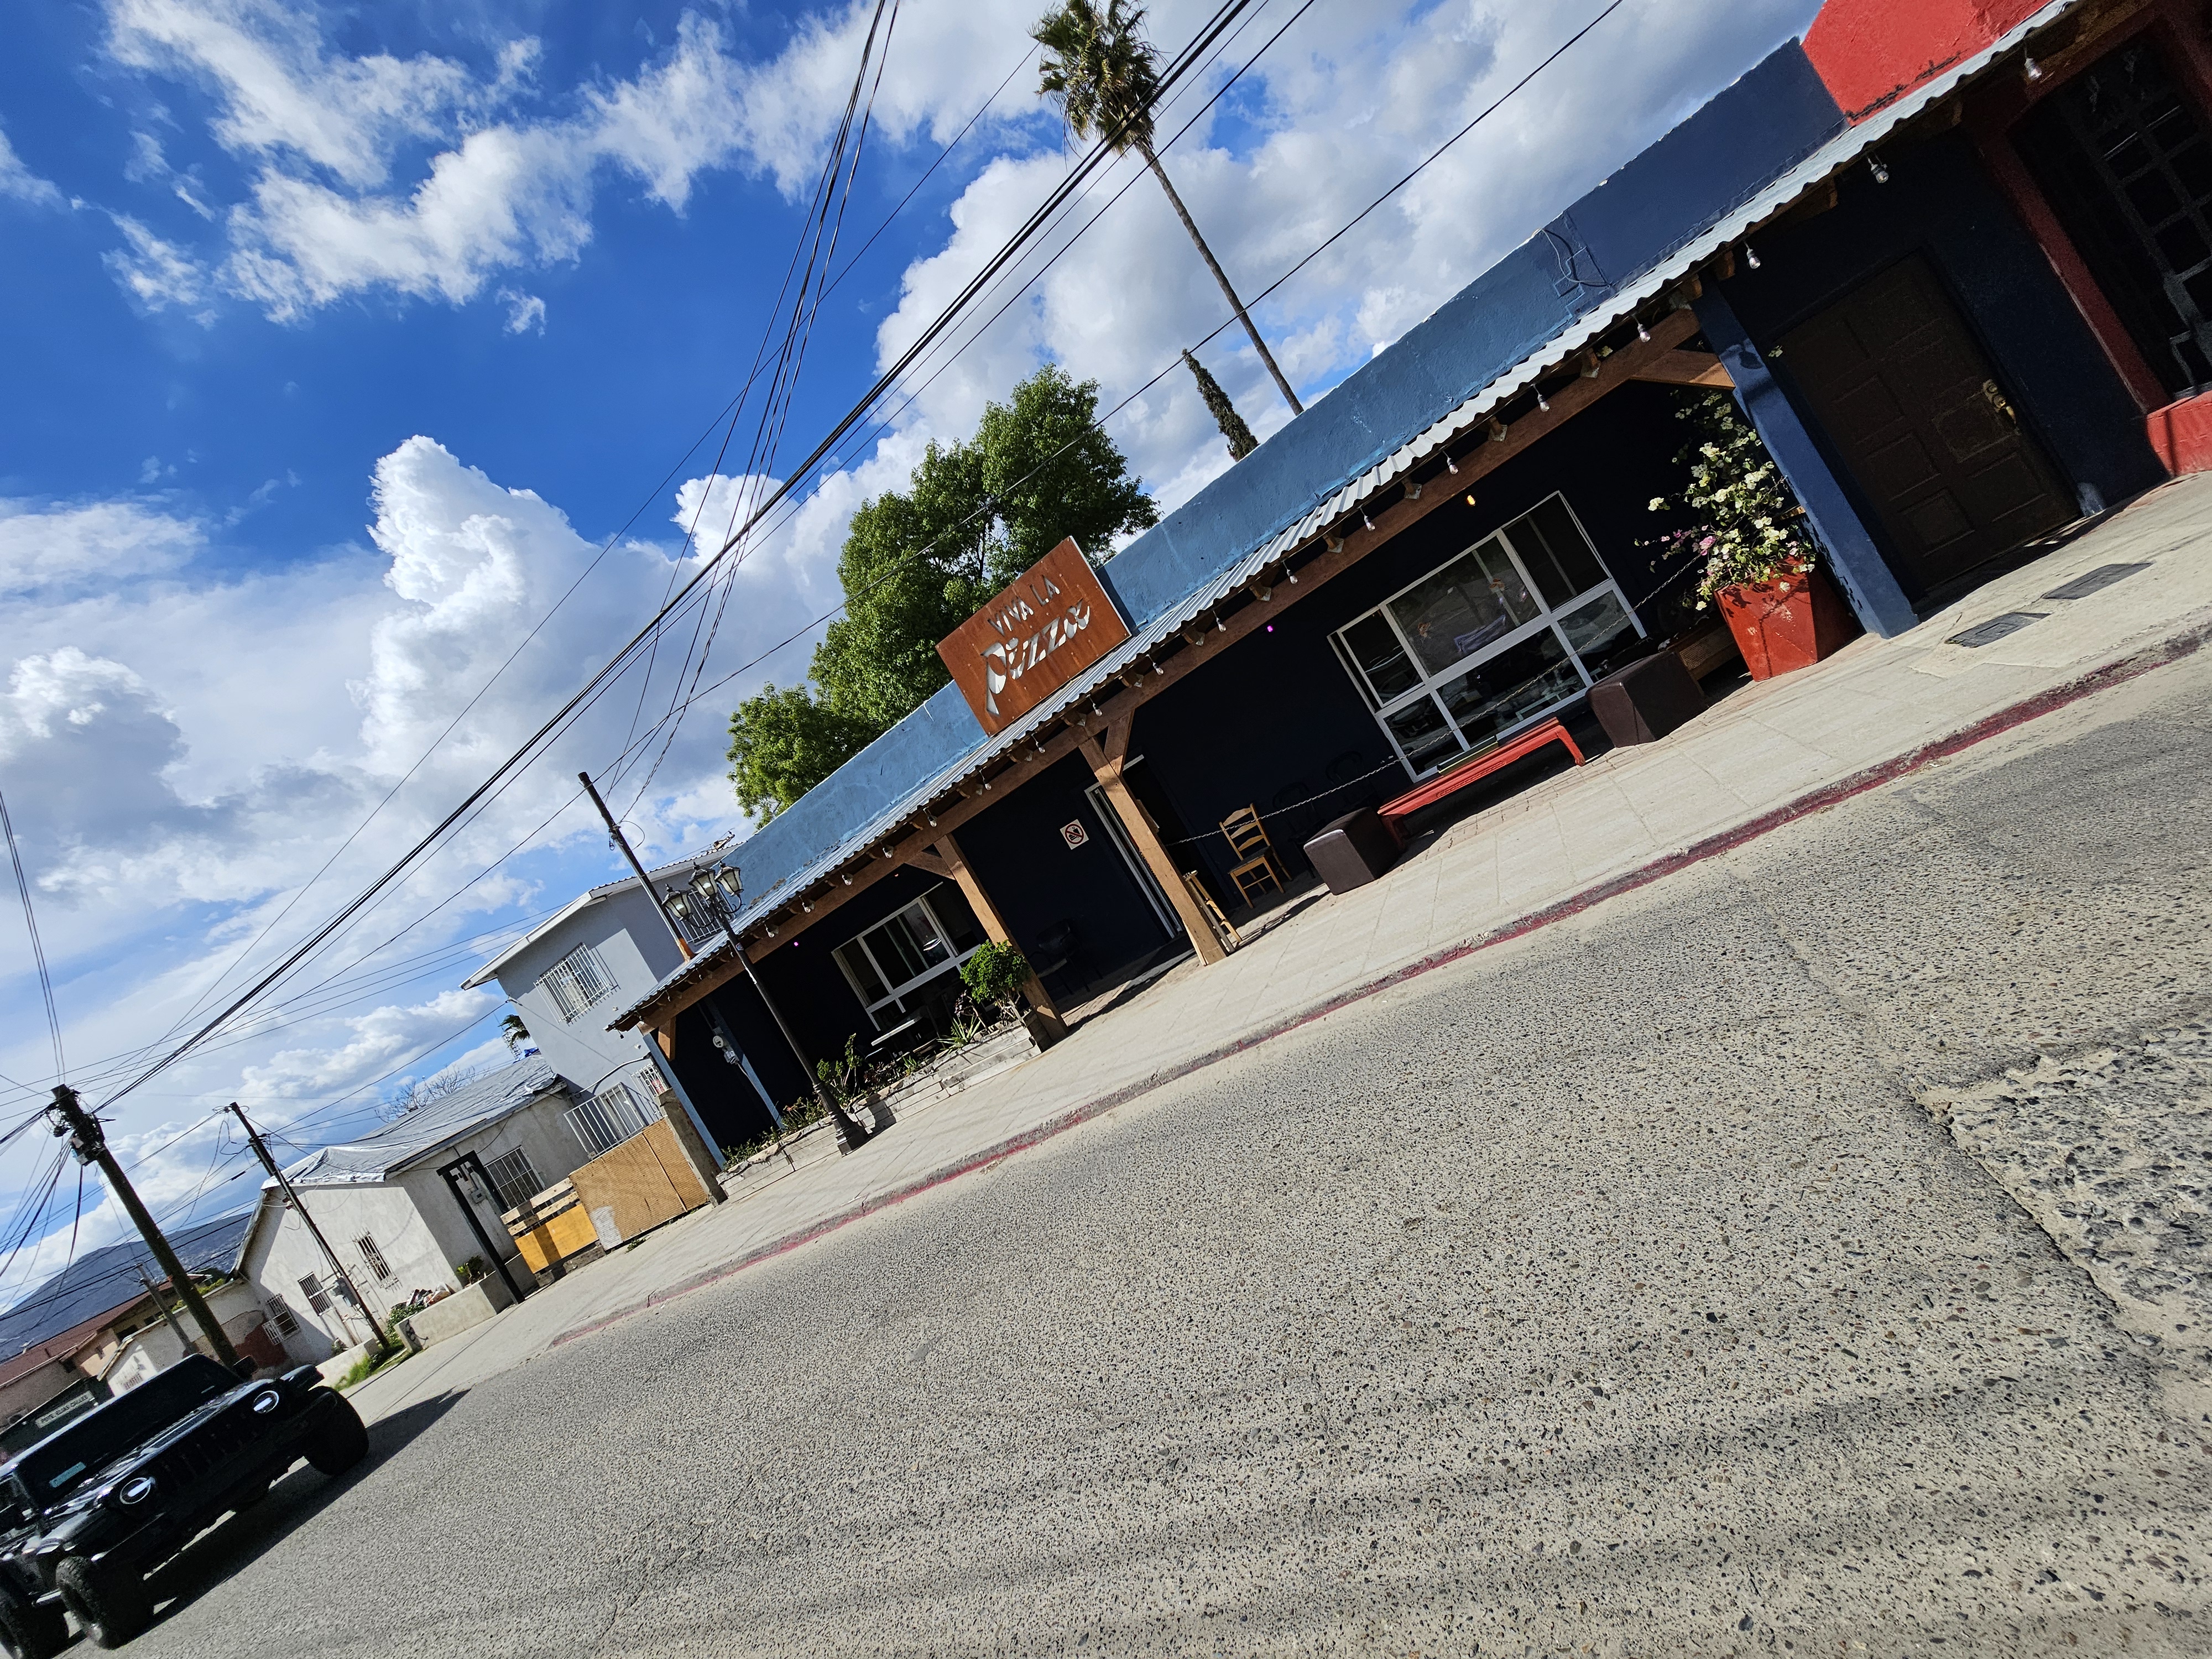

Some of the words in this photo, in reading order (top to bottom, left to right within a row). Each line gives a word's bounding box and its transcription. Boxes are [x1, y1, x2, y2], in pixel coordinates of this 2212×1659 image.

[987, 596, 1034, 636] VIVA
[1030, 575, 1060, 606] LA
[980, 599, 1091, 715] Pizza
